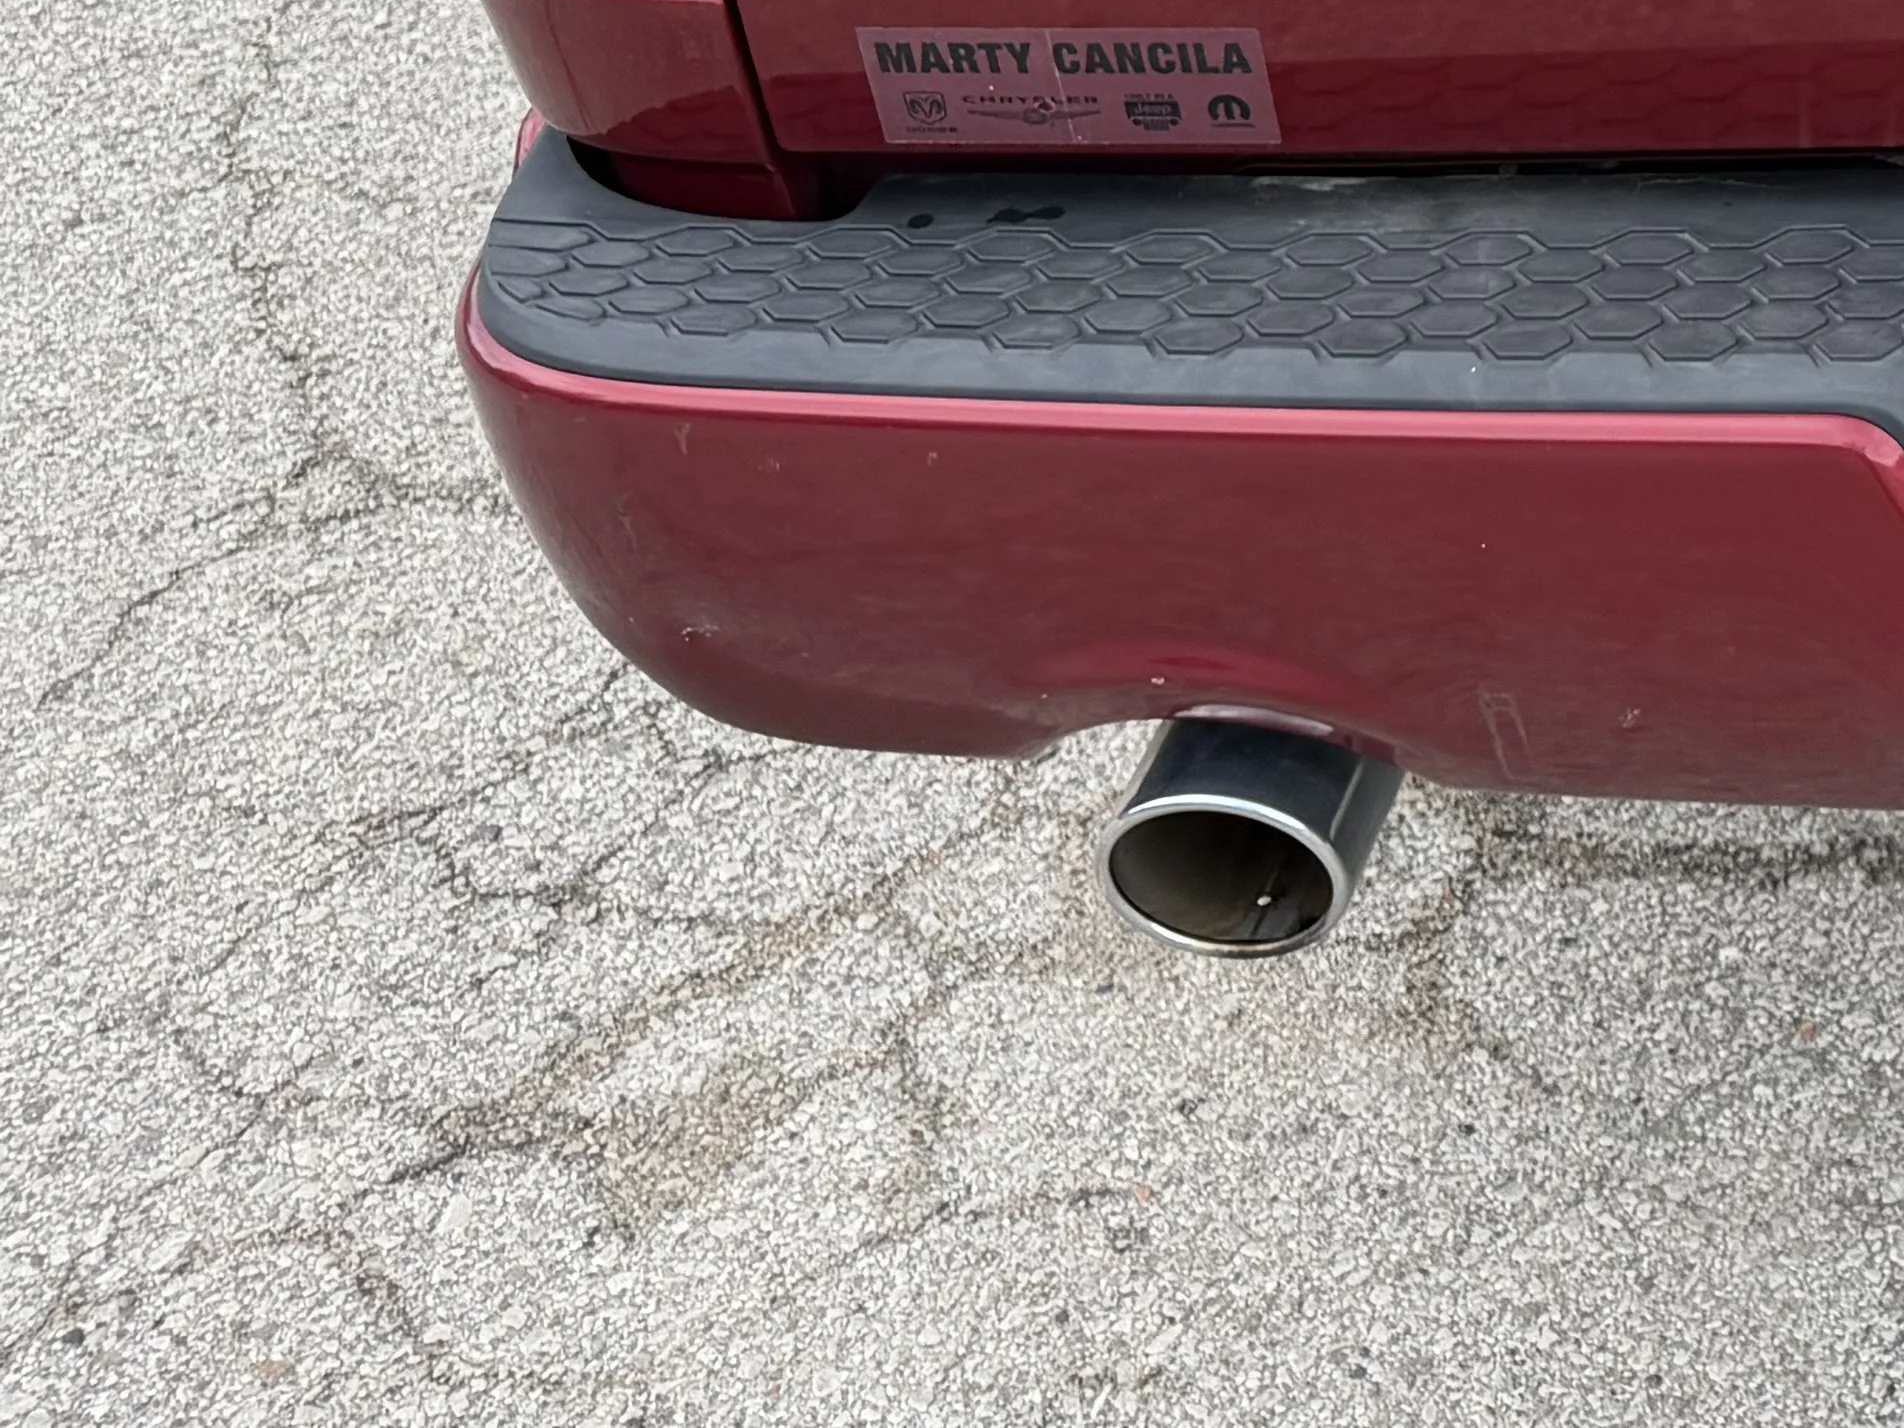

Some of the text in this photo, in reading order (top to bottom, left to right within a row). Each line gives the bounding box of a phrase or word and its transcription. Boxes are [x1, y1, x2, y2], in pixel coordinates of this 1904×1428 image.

[874, 41, 1253, 75] MARTY CANCILA
[1133, 102, 1172, 115] Jeep
